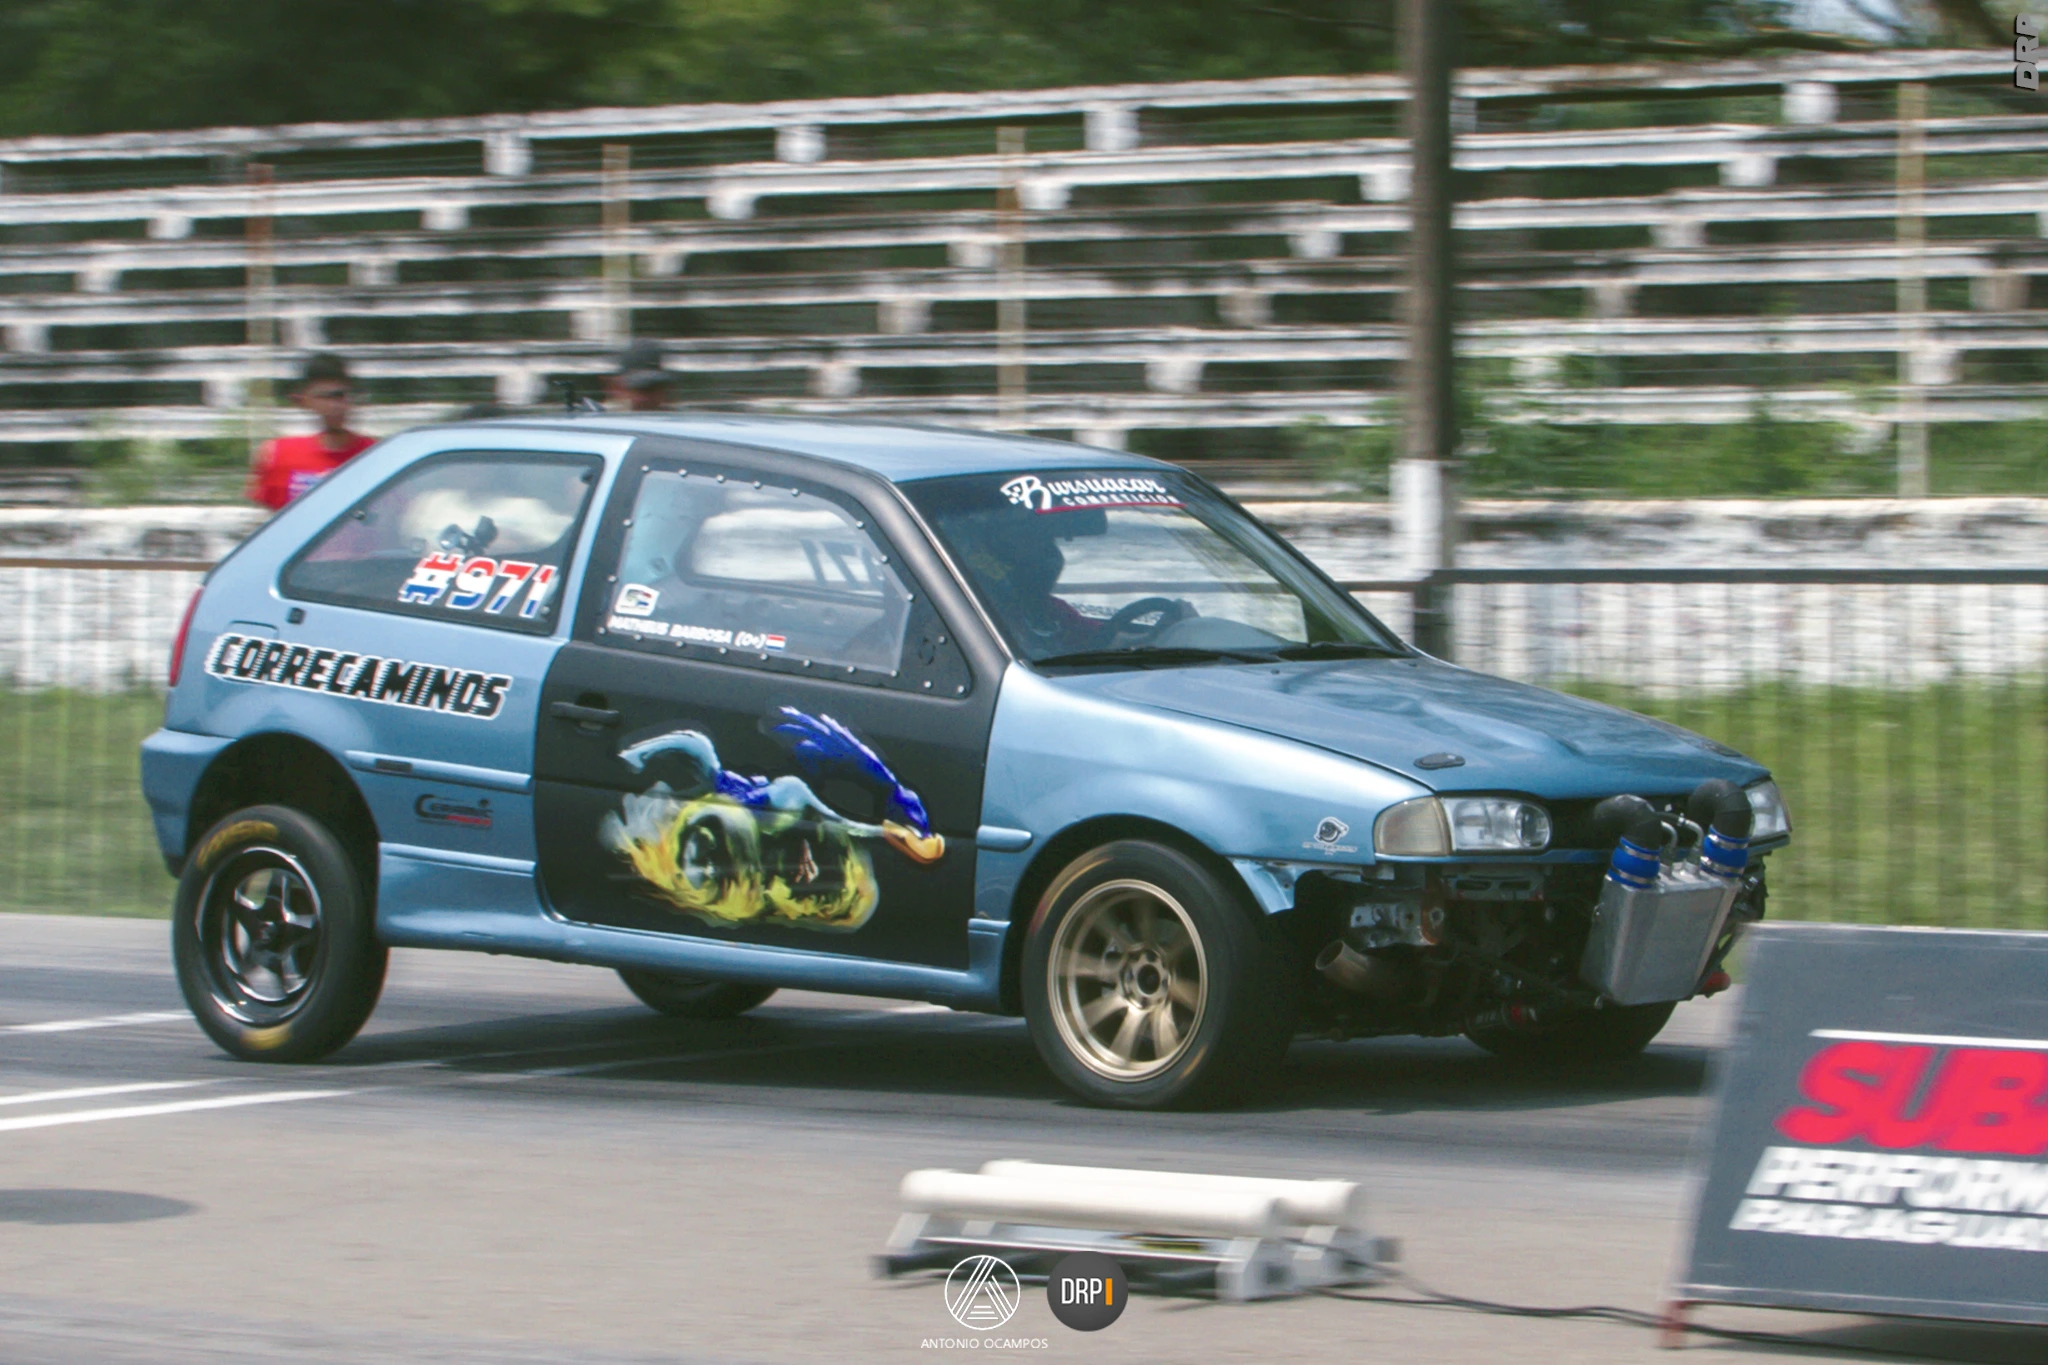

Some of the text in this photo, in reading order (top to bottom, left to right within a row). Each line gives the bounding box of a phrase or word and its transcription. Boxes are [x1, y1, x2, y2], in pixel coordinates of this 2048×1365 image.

[397, 551, 557, 618] #971
[670, 623, 733, 645] BARBOSA
[204, 631, 514, 720] CORRECAMINOS
